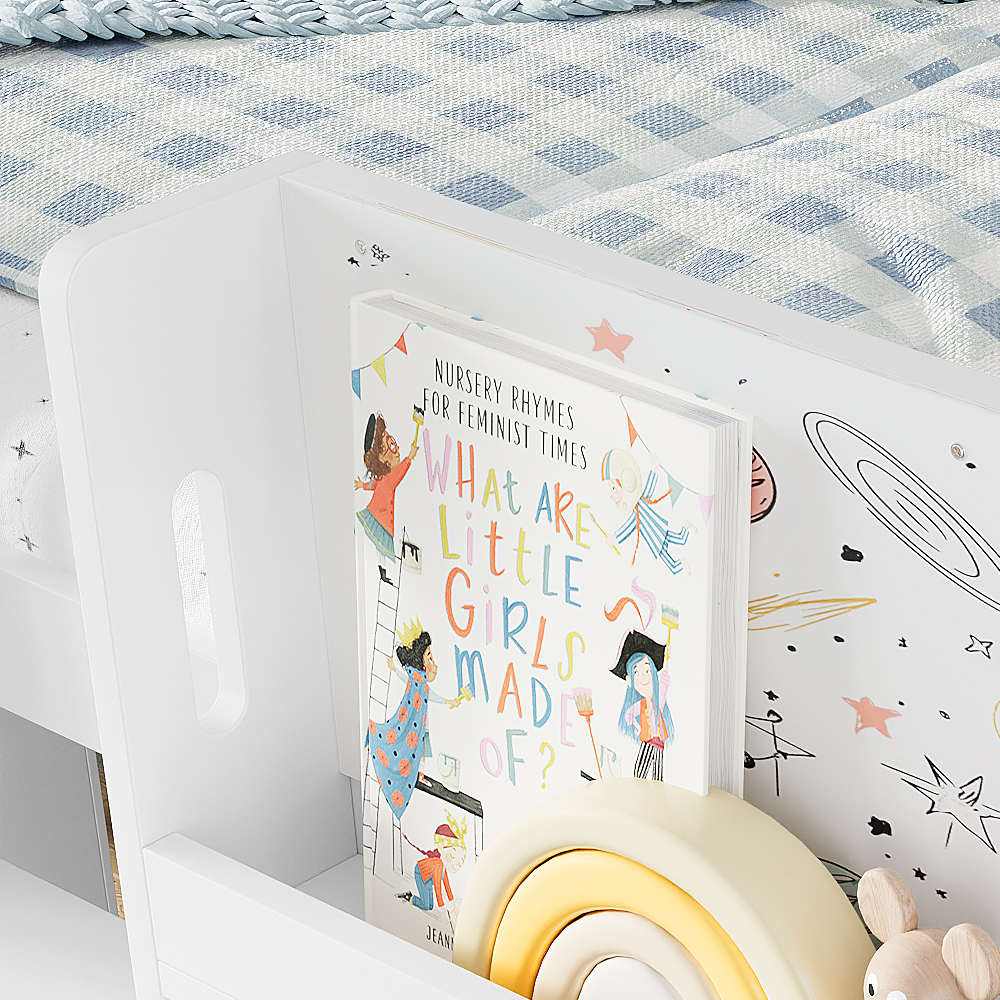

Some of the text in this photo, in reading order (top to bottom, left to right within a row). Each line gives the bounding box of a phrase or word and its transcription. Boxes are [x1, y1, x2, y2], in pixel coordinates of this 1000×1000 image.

[423, 388, 587, 470] FOR FEMINIST TIMES
[435, 358, 574, 431] NURSERY RHYMES
[535, 481, 591, 549] ARE
[480, 729, 555, 790] OF?
